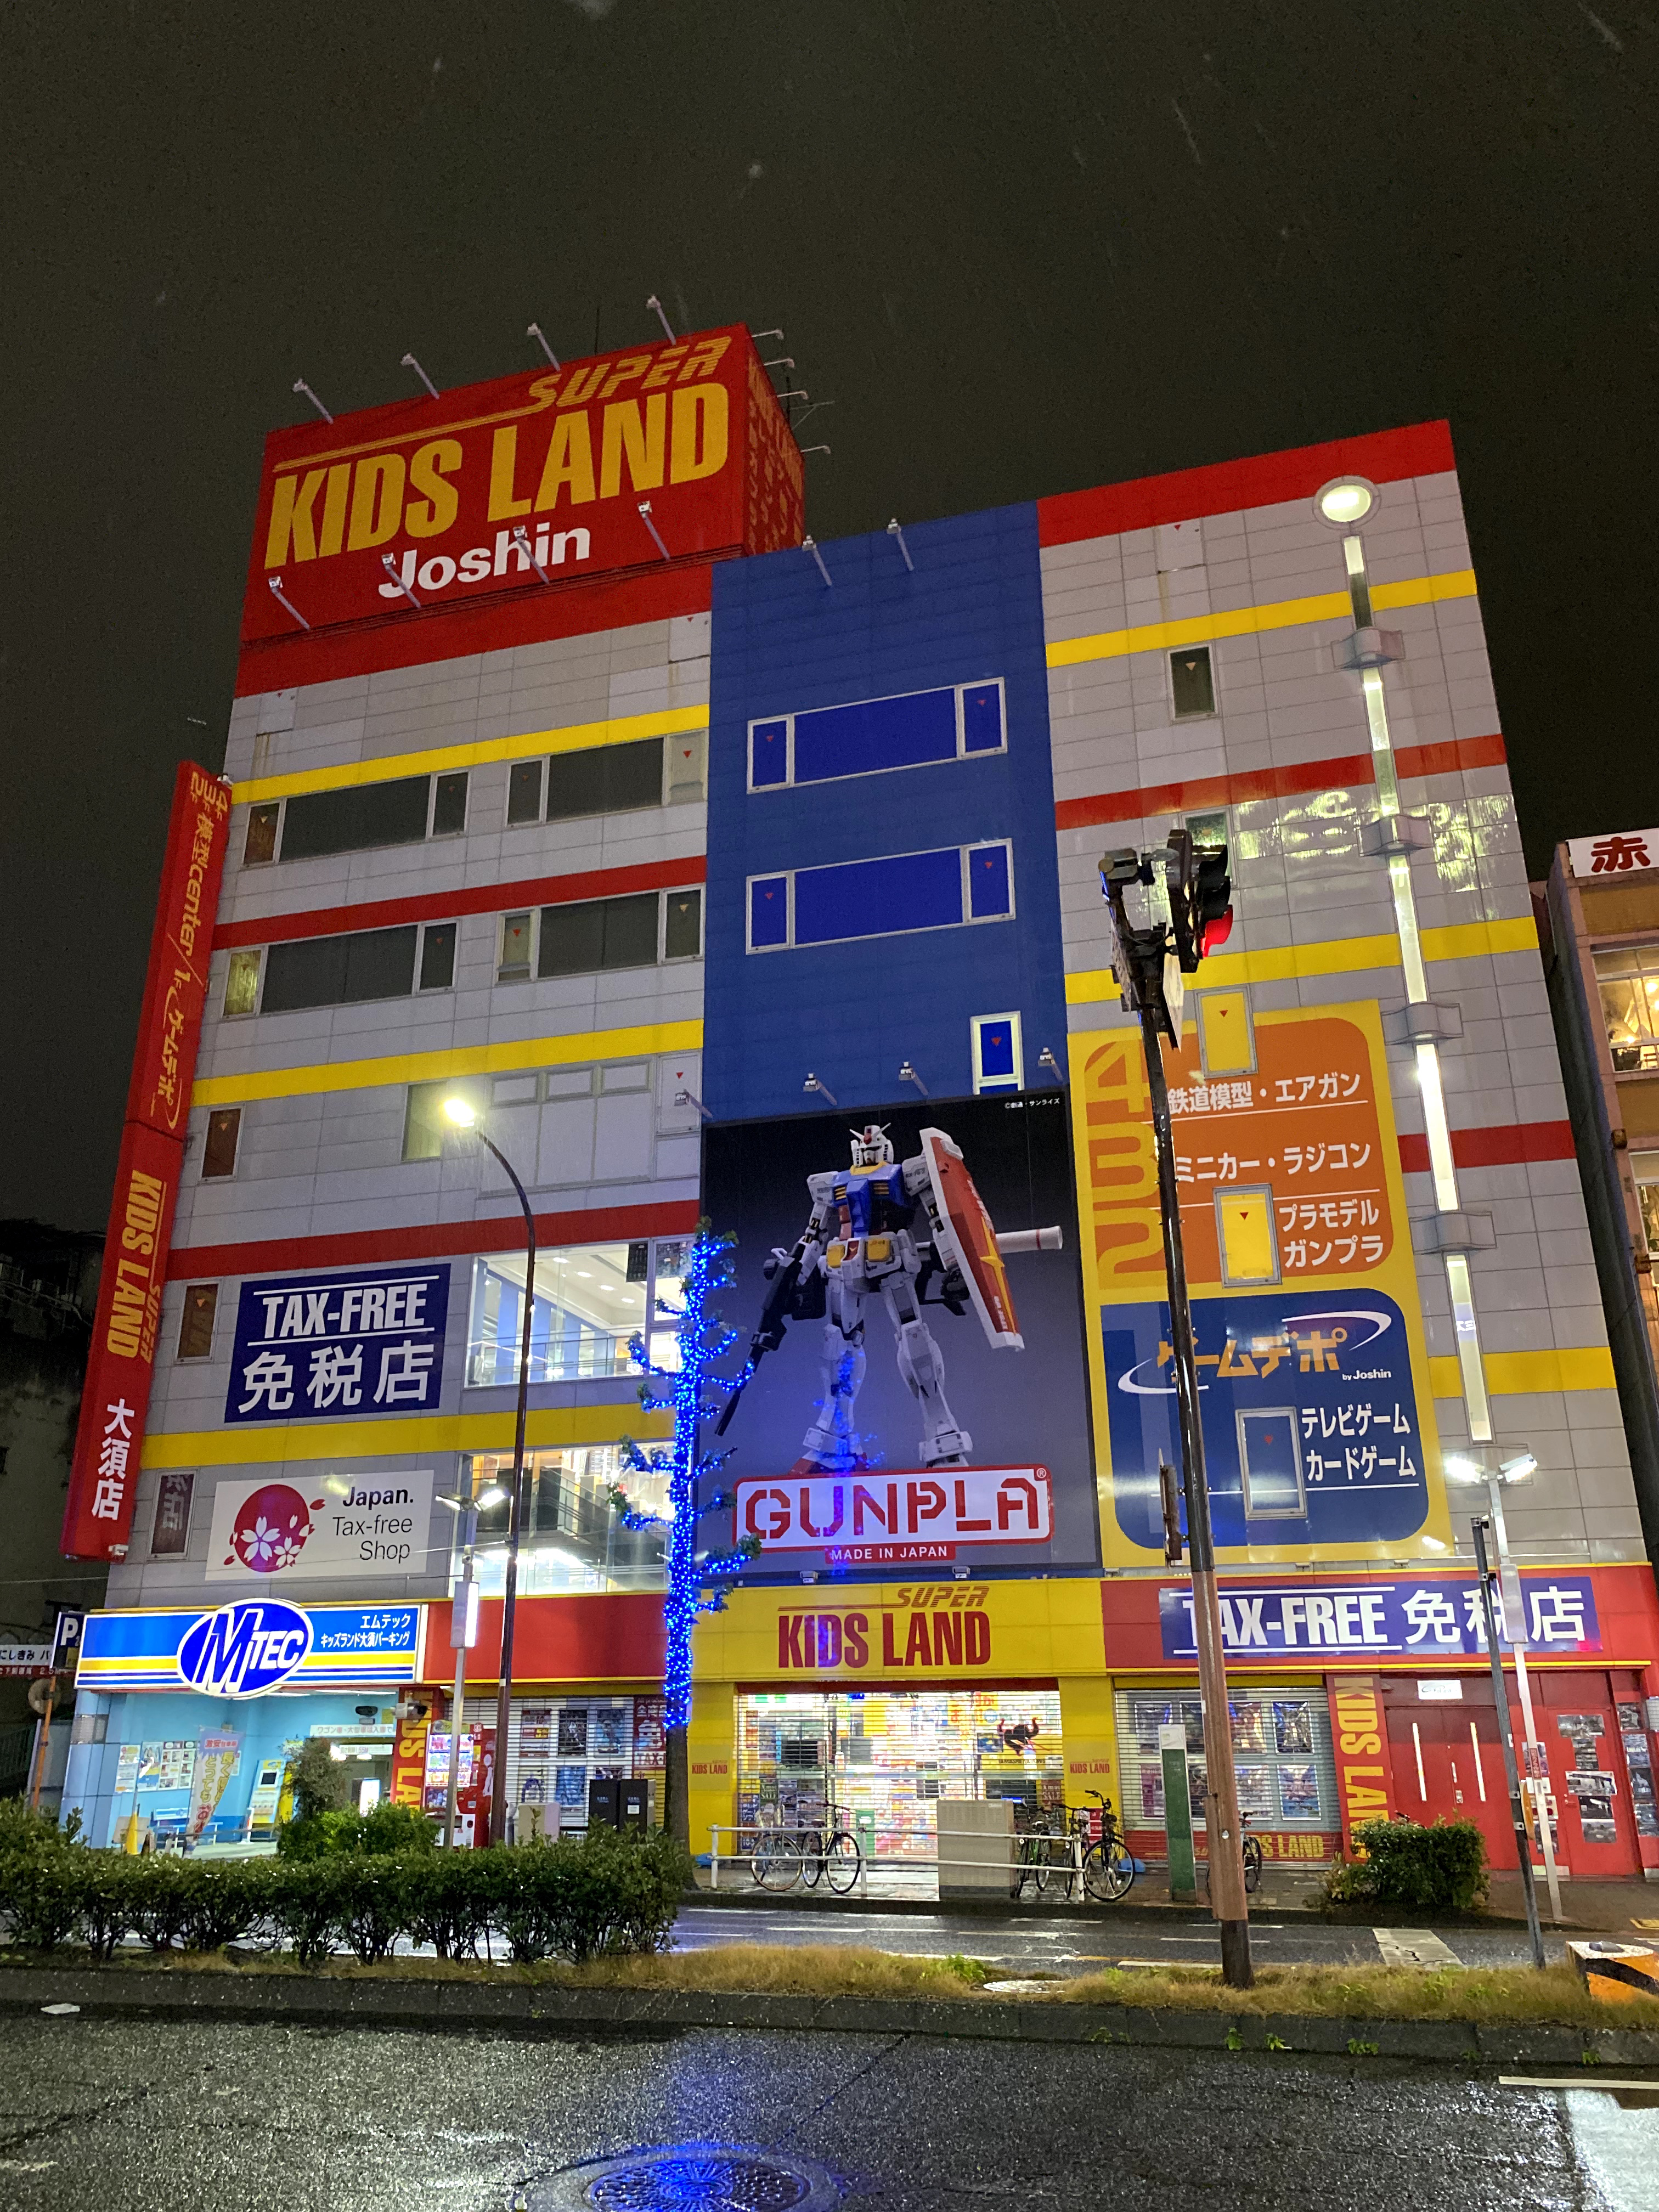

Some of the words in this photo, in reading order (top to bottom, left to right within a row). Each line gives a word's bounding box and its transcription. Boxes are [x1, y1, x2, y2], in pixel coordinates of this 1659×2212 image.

[528, 336, 732, 409] SUPER
[264, 439, 462, 570] KIDS
[488, 383, 729, 522] LAND
[378, 523, 590, 598] Joshin
[1591, 837, 1651, 873] 赤
[1167, 1072, 1360, 1114] 鉄道模型・エアガン
[1176, 1143, 1370, 1182] ミニカー・ラジコン
[122, 1169, 163, 1255] KIDS
[1279, 1199, 1379, 1232] プラモデル
[1284, 1235, 1383, 1268] ガンプラ
[107, 1258, 149, 1358] LAND
[140, 1283, 162, 1364] SUPER
[263, 1284, 427, 1339] TAX-FREE
[238, 1340, 435, 1413] 免税店
[1353, 1369, 1391, 1379] Joshin
[1302, 1404, 1410, 1439] テレビゲーム
[92, 1398, 135, 1520] 大須店
[1306, 1446, 1417, 1481] カードゲーム
[343, 1487, 414, 1509] Japan.
[746, 1477, 1039, 1539] GUNPLA
[333, 1516, 413, 1536] Tax-free
[360, 1541, 410, 1563] Shop
[832, 1547, 873, 1560] MADE
[879, 1545, 893, 1558] IN
[900, 1545, 947, 1559] JAPAN
[897, 1587, 990, 1608] SUPER
[60, 1617, 78, 1645] P
[360, 1613, 411, 1628] エムテック
[1183, 1594, 1388, 1646] TAX-FREE
[192, 1608, 304, 1693] MTEC
[321, 1630, 410, 1647] キッズランド大須パーキング
[778, 1613, 868, 1669] KIDS
[883, 1611, 991, 1666] LAND
[1334, 1678, 1381, 1754] KIDS
[692, 1764, 707, 1774] KIDS
[709, 1764, 727, 1774] LAND
[1070, 1763, 1087, 1773] KIDS
[1090, 1763, 1110, 1773] LAND
[1278, 1835, 1324, 1858] LAND
